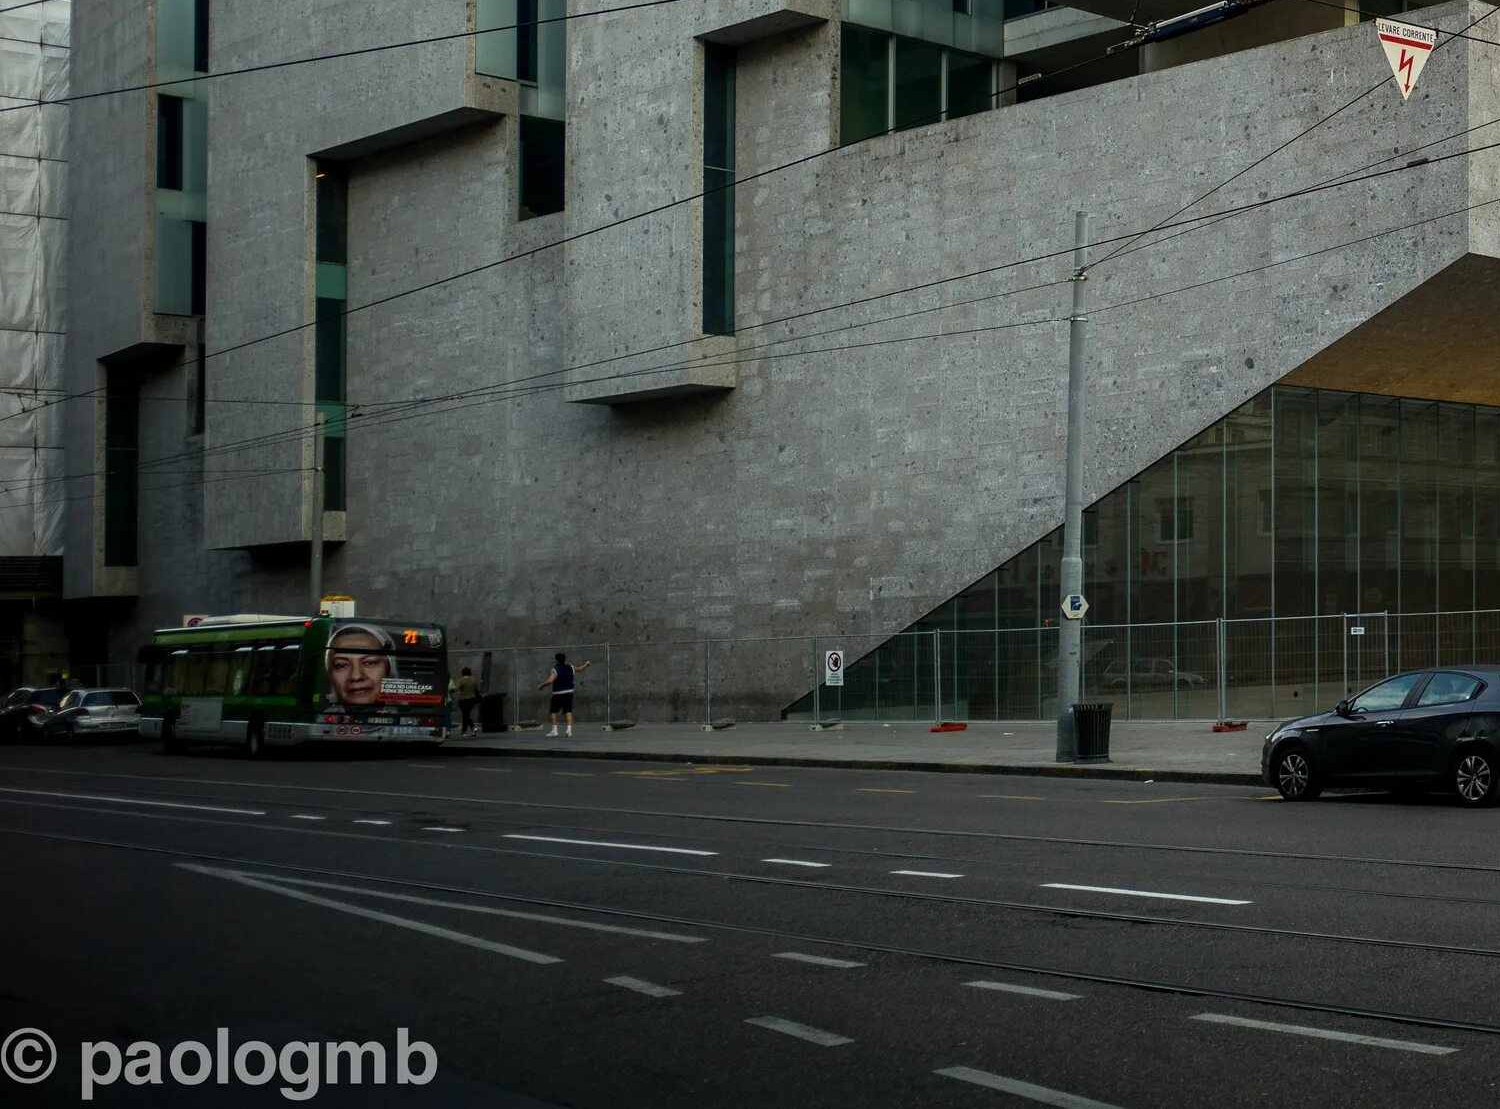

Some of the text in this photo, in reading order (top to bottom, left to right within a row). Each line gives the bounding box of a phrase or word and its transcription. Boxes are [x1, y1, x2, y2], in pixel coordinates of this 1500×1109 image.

[1378, 23, 1434, 42] LEVARE CORRENTE
[404, 629, 419, 644] 71
